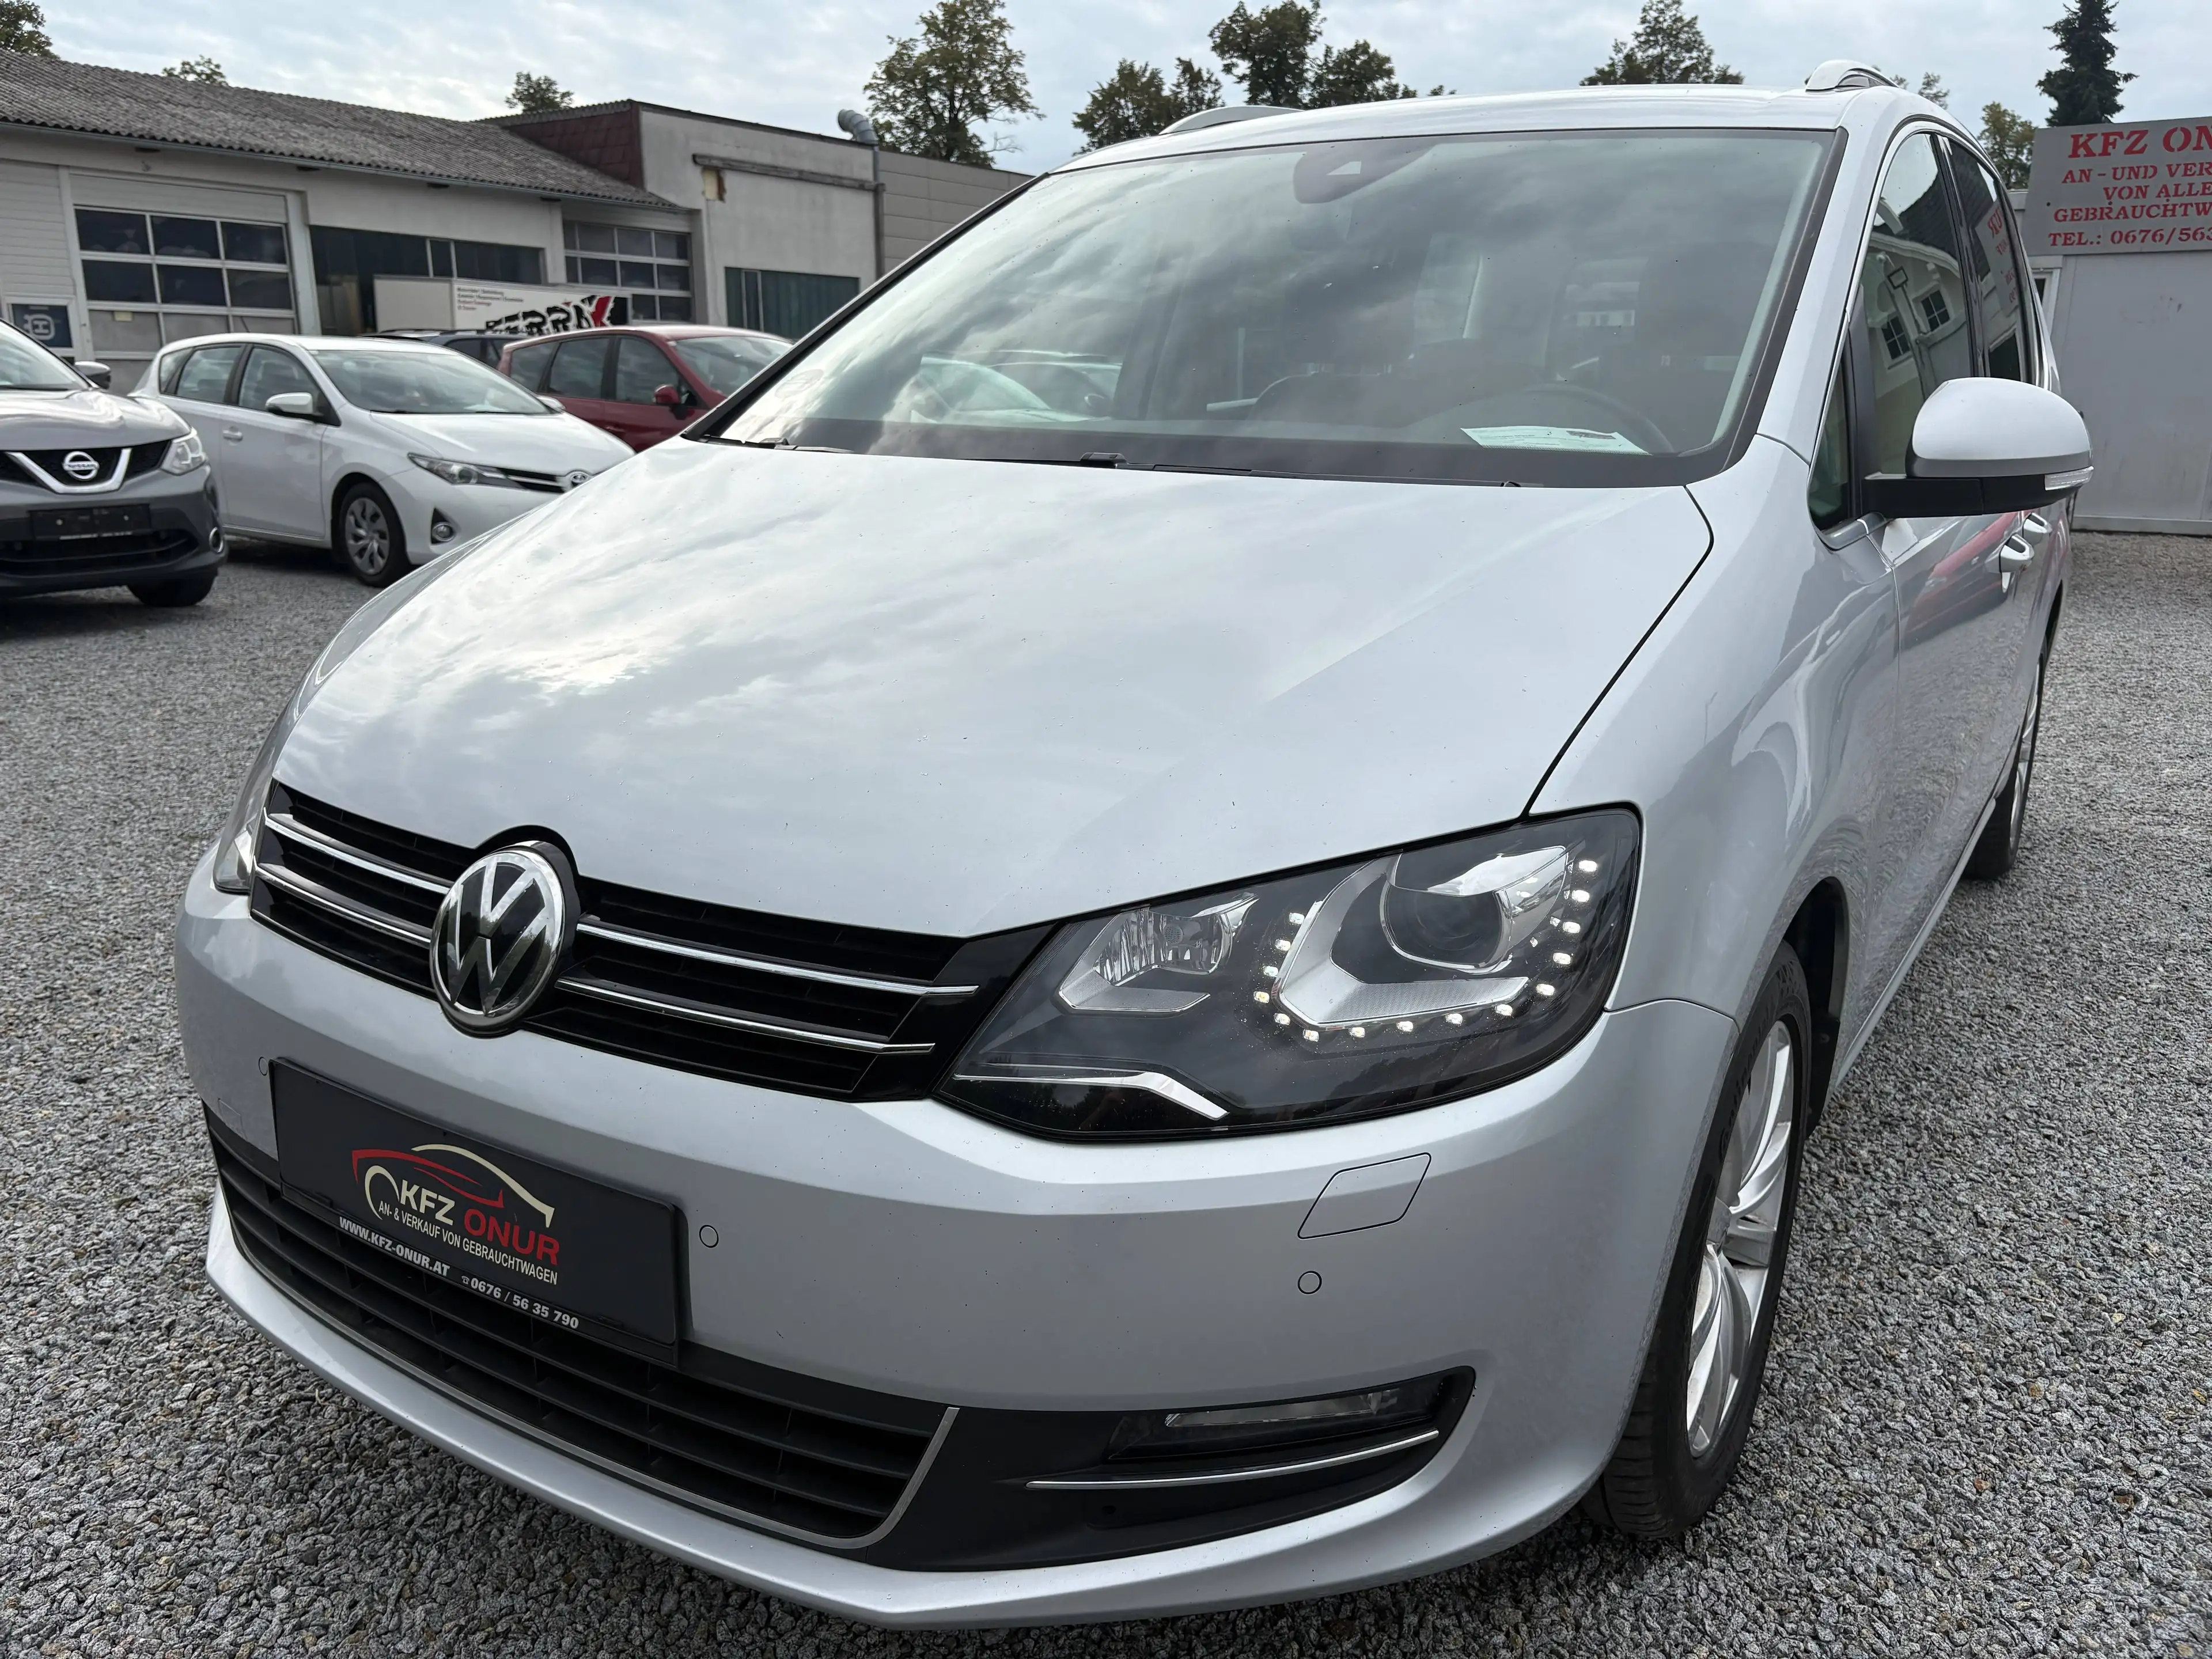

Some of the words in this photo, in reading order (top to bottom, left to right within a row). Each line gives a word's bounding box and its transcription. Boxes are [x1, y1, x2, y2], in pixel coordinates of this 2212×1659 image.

[2068, 130, 2149, 158] KFZ
[2166, 162, 2212, 177] VER
[2103, 185, 2150, 200] VON
[2156, 182, 2212, 198] ALLE
[2054, 202, 2212, 222] GEBRAUCHTW
[2048, 232, 2101, 247] TEL.:
[400, 1180, 455, 1226] KFZ
[464, 1209, 560, 1266] ONUR
[379, 1200, 392, 1217] AN-
[394, 1208, 400, 1221] &
[402, 1211, 441, 1238] VERKAUF
[442, 1229, 460, 1248] VON
[463, 1238, 558, 1285] GEBRAUCHTWAGEN
[340, 1217, 450, 1277] WWW.KFZ-ONUR.AT
[471, 1278, 502, 1298] 0676
[504, 1291, 510, 1302] /
[513, 1294, 529, 1309] 56
[532, 1302, 549, 1317] 35
[554, 1310, 579, 1329] 790
